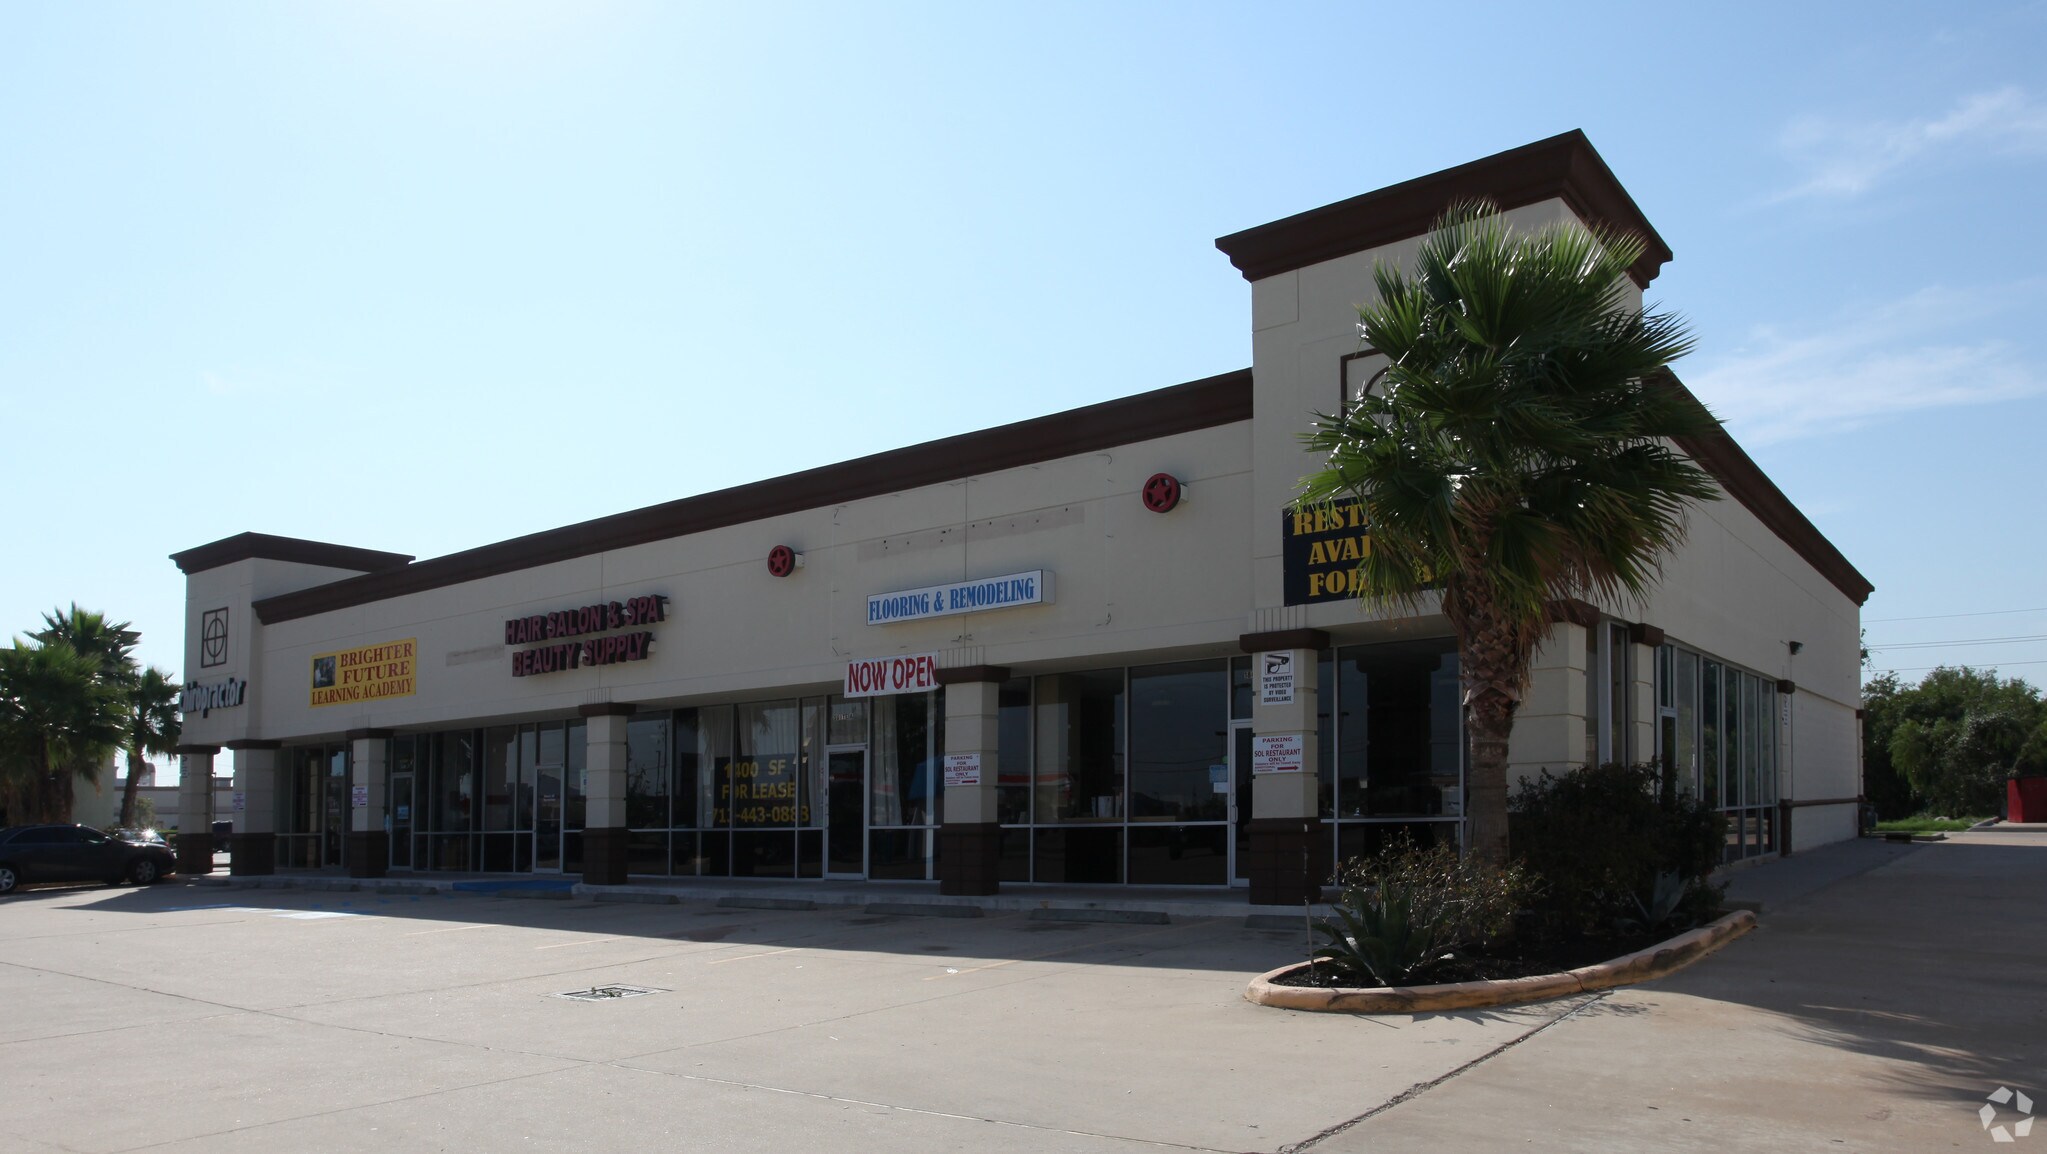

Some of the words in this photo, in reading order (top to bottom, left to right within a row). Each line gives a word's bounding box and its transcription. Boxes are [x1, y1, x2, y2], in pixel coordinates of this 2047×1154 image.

[868, 592, 930, 622] FLOORING
[933, 590, 945, 613] &
[949, 576, 1035, 610] REMODELING
[505, 615, 546, 645] HAIR
[546, 604, 606, 639] SALON
[606, 600, 622, 629] &
[625, 594, 664, 626] SPA
[340, 642, 413, 668] BRIGHTER
[512, 642, 581, 677] BEAUTY
[582, 632, 651, 667] SUPPLY
[342, 661, 410, 684] FUTURE
[848, 660, 888, 693] NOW
[892, 655, 937, 690] OPEN
[311, 685, 360, 706] LEARNING
[362, 678, 413, 699] ACADEMY
[1262, 736, 1293, 744] PARKING
[1265, 748, 1301, 757] RESTAURANT
[767, 759, 786, 776] SF
[752, 781, 796, 799] LEASE
